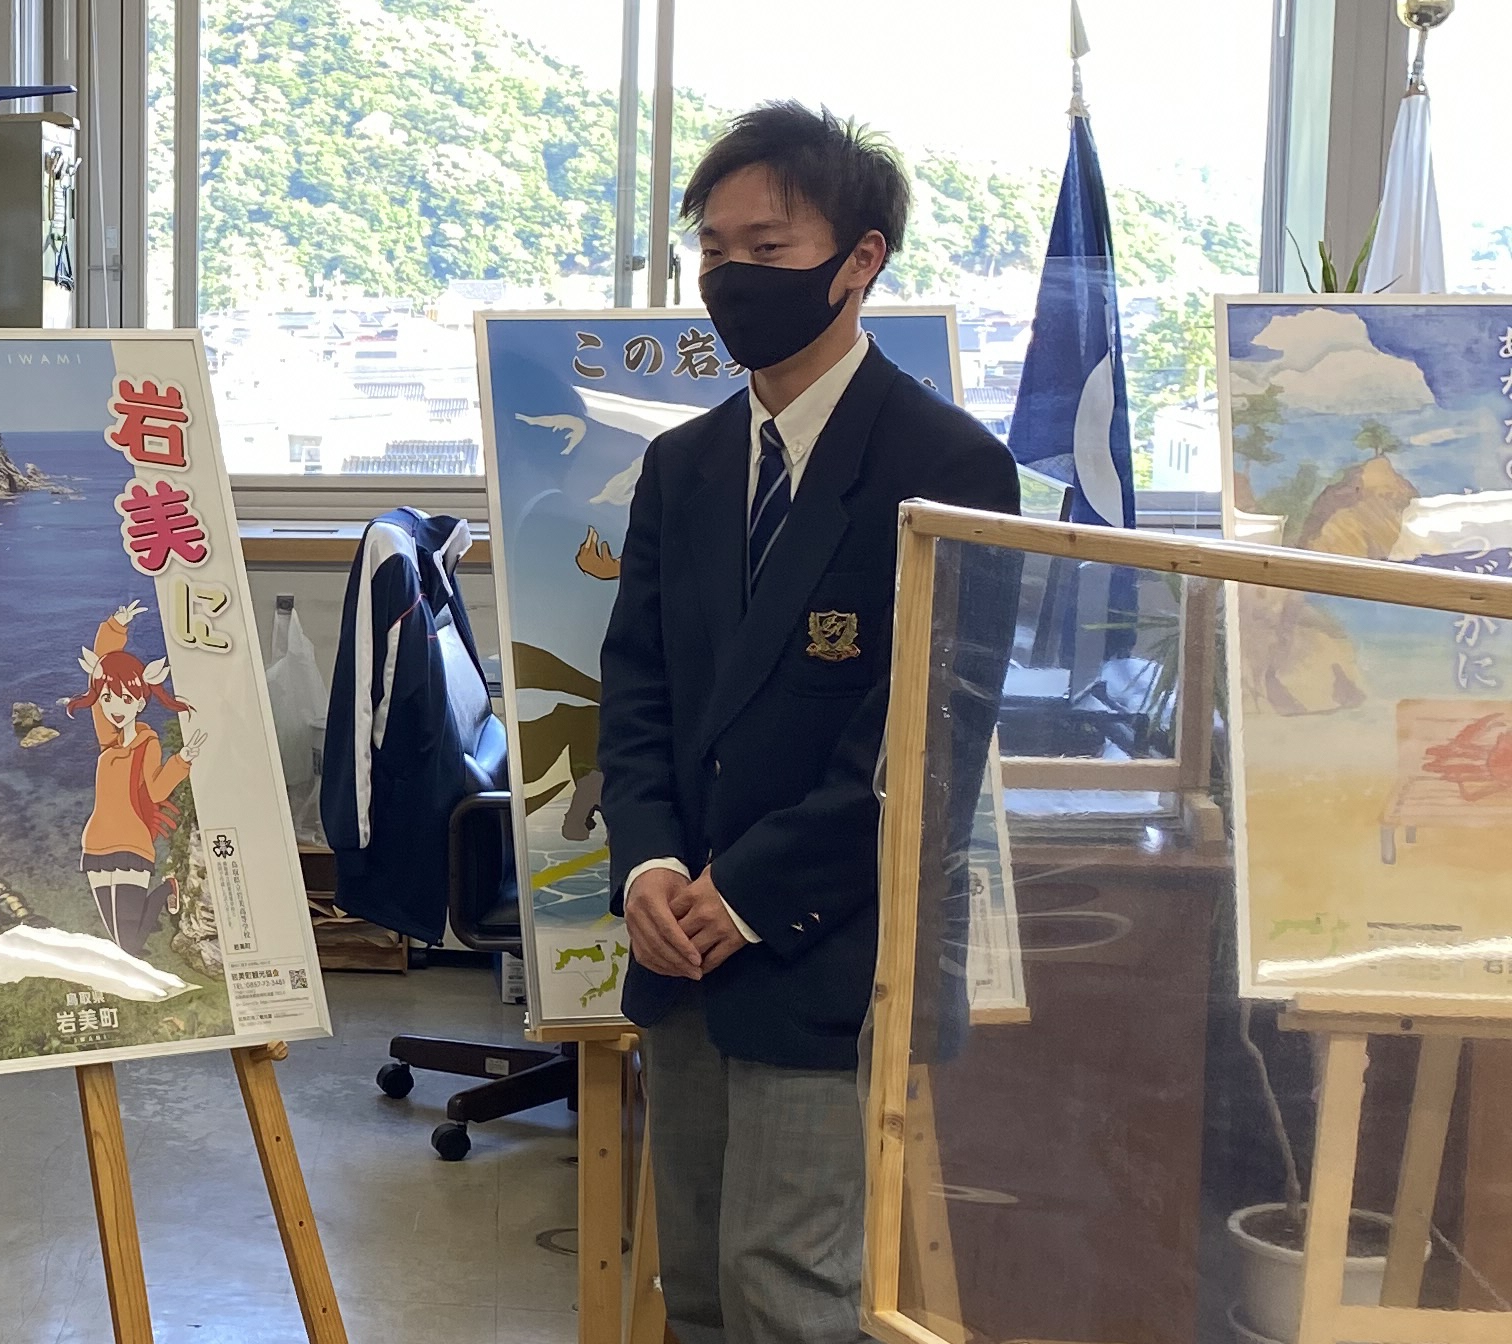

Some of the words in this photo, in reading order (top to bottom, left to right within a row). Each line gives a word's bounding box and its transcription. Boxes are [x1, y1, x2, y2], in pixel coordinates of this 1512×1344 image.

[7, 354, 82, 365] IWAMI
[573, 327, 749, 380] この岩
[110, 377, 231, 651] 岩美に
[66, 990, 105, 1007] 鳥取県
[56, 1007, 120, 1034] 岩美町
